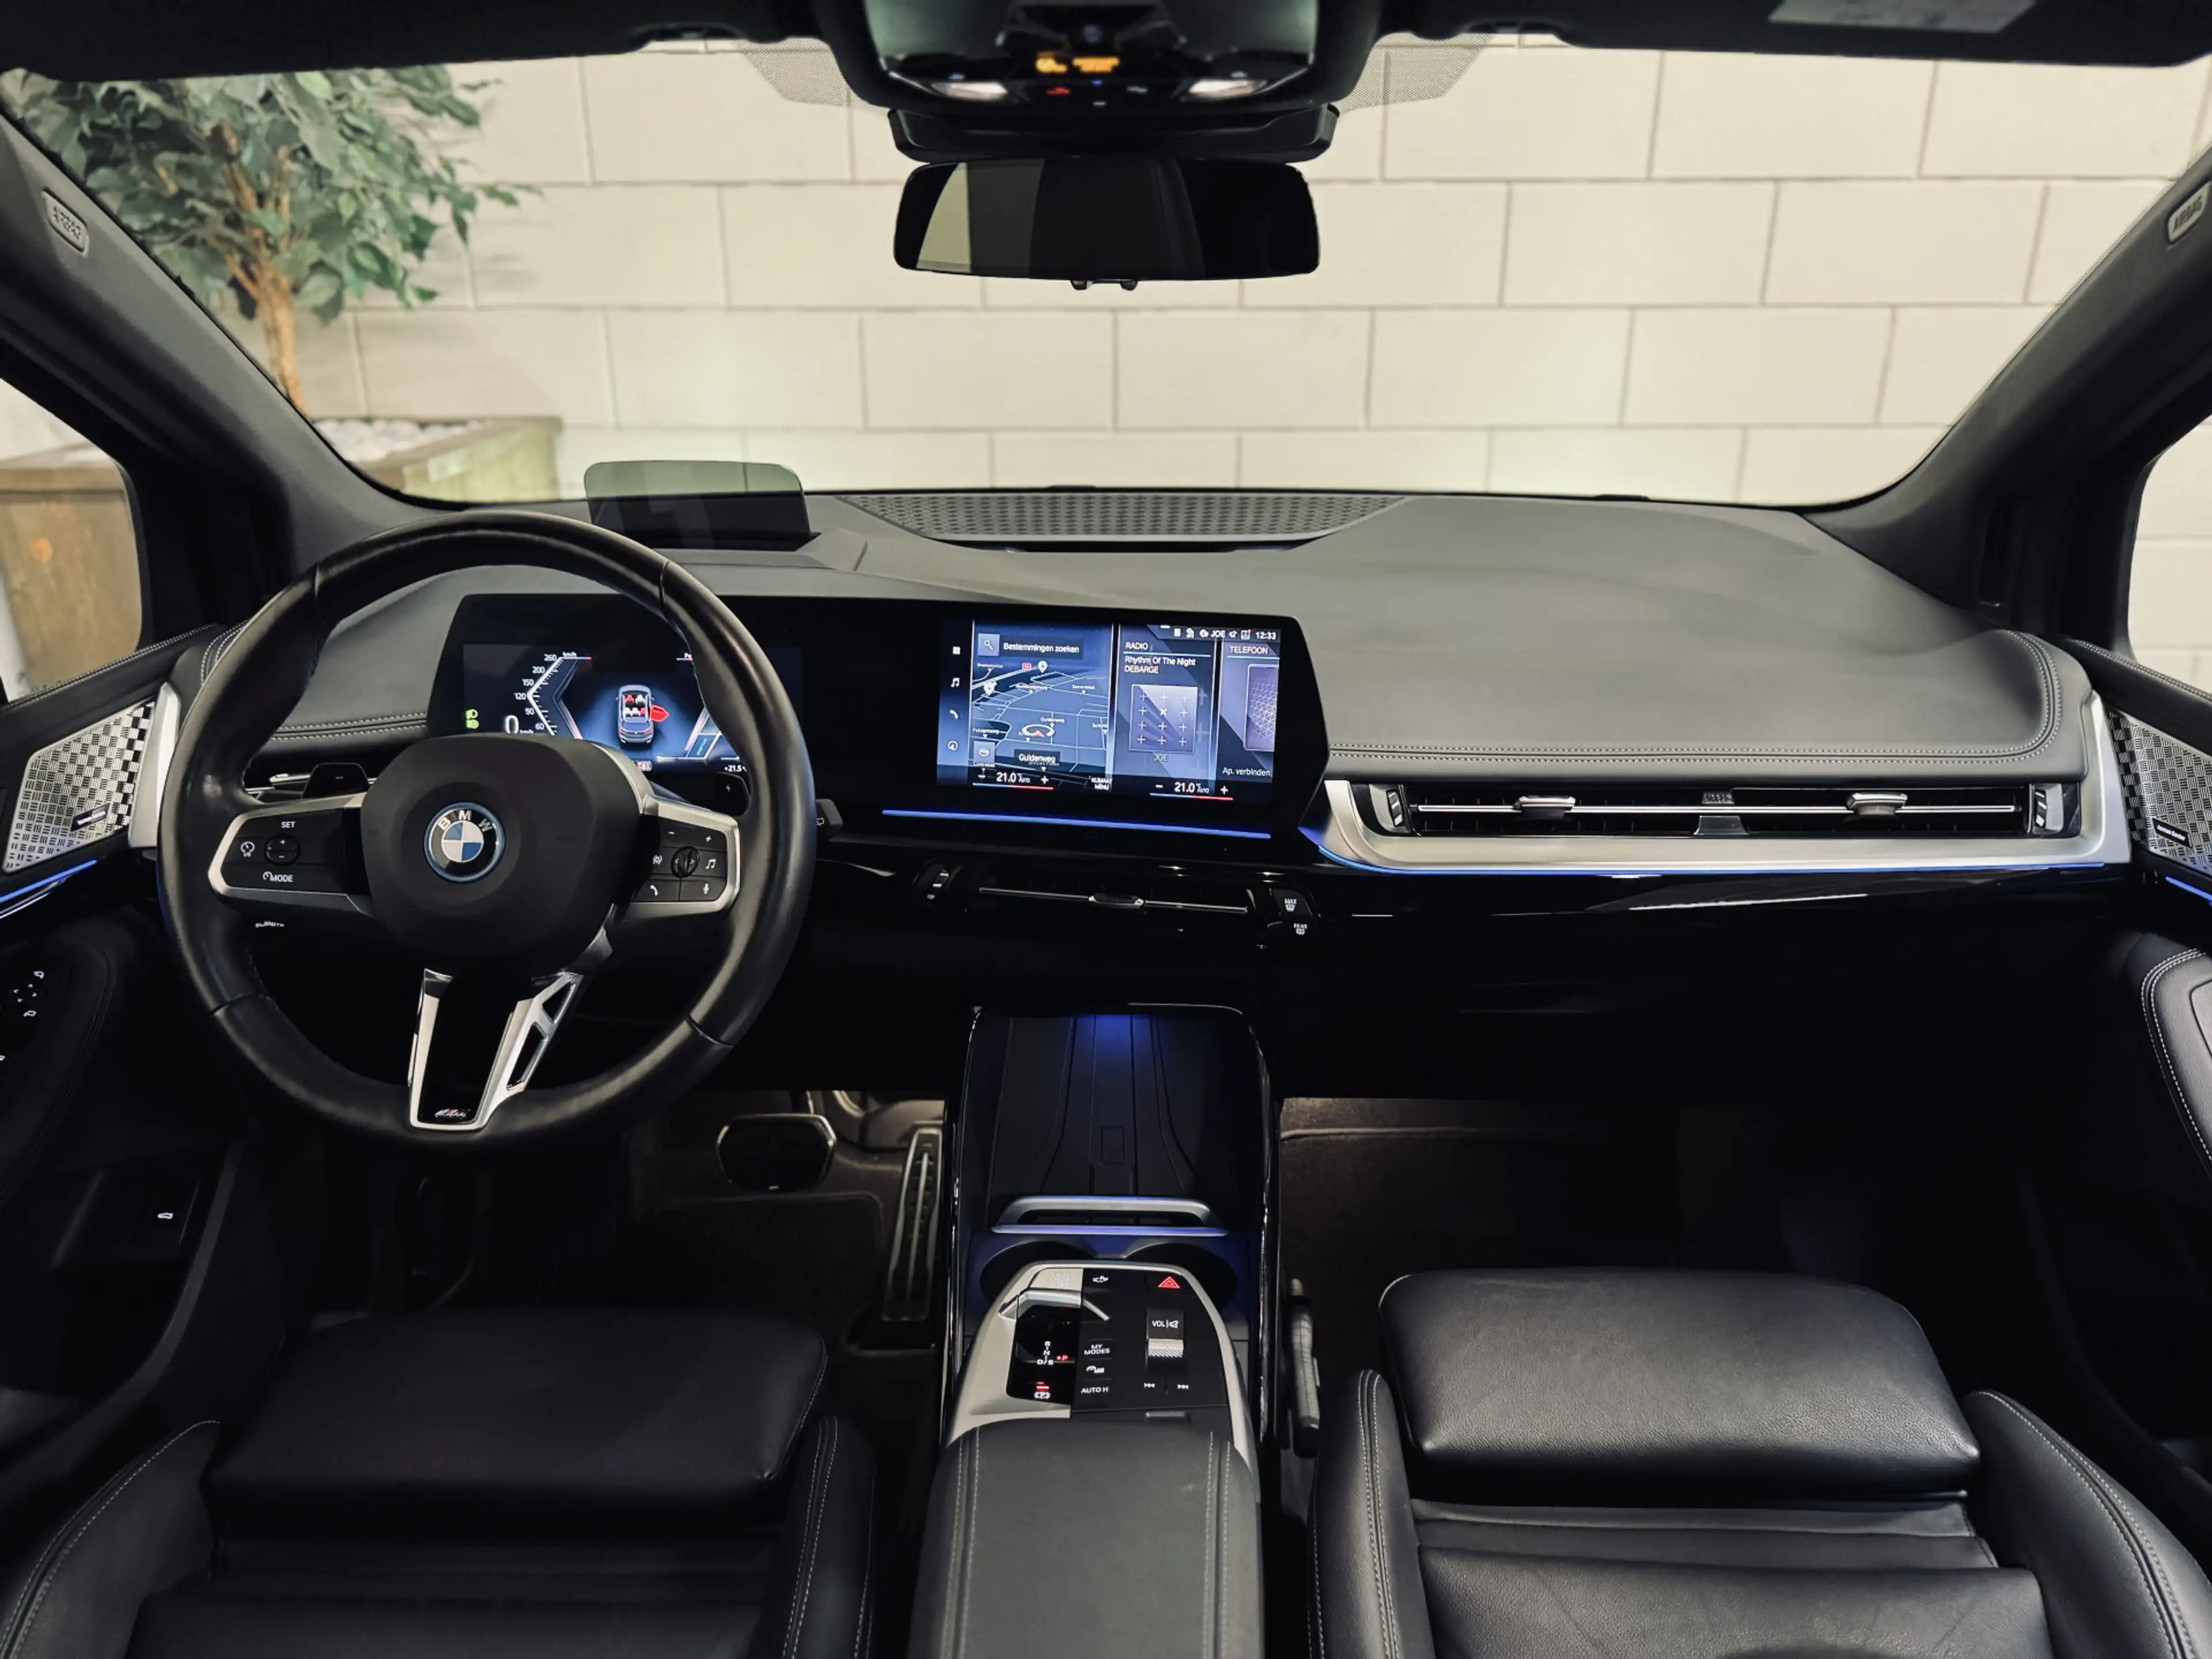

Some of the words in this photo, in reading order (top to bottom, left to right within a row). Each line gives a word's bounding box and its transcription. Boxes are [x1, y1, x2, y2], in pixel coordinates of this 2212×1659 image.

[1211, 630, 1225, 638] JOE
[1256, 631, 1276, 639] 12:33
[1003, 642, 1054, 653] Bestemmingen
[1055, 645, 1079, 653] zoeken
[1125, 642, 1148, 650] RADIO
[1229, 645, 1268, 654] TELEFOON
[1125, 656, 1151, 665] Rhythm
[1177, 658, 1196, 666] Night
[532, 666, 546, 674] 200
[1124, 665, 1158, 673] DEBARGE
[522, 679, 535, 687] 150
[504, 715, 520, 734] 0
[1018, 753, 1056, 764] Guldenweg
[1153, 752, 1168, 762] JOE
[996, 772, 1016, 783] 21.0
[1174, 782, 1195, 793] 21.0
[438, 810, 493, 832] BMW
[270, 874, 294, 882] MODE
